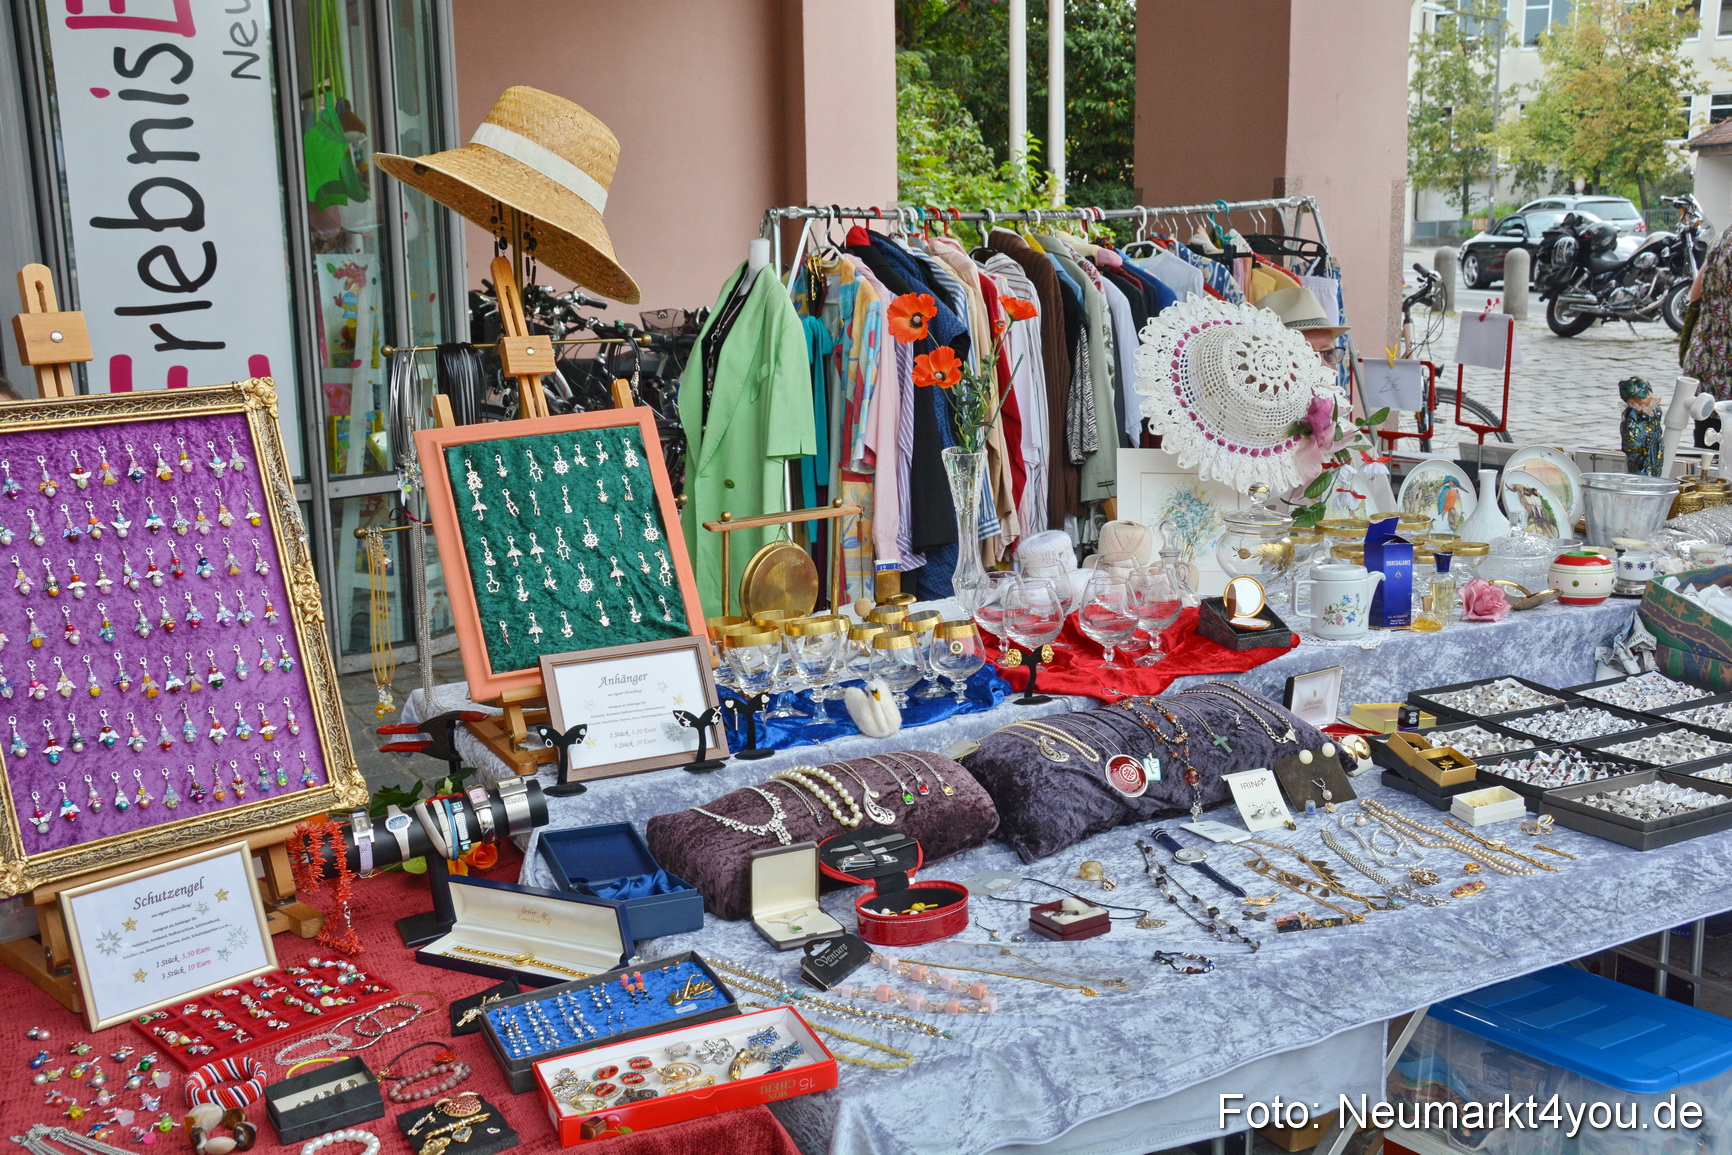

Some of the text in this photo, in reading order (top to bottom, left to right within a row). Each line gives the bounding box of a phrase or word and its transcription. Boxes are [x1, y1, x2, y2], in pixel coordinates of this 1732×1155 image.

[1379, 376, 1401, 393] 2€
[598, 673, 648, 688] Anhänger
[613, 728, 630, 738] Stück
[631, 728, 642, 736] 3.50
[618, 741, 635, 749] Stück
[1240, 780, 1263, 789] IRINA
[133, 876, 204, 910] Schutzengel
[161, 955, 180, 966] Stück
[182, 951, 194, 960] 3.50
[195, 946, 211, 955] Euro
[814, 943, 848, 966] Venture
[167, 967, 186, 978] Stück
[196, 960, 211, 968] Euro
[760, 1079, 796, 1094] CHERI
[799, 1077, 815, 1090] 15
[769, 1091, 788, 1100] MON
